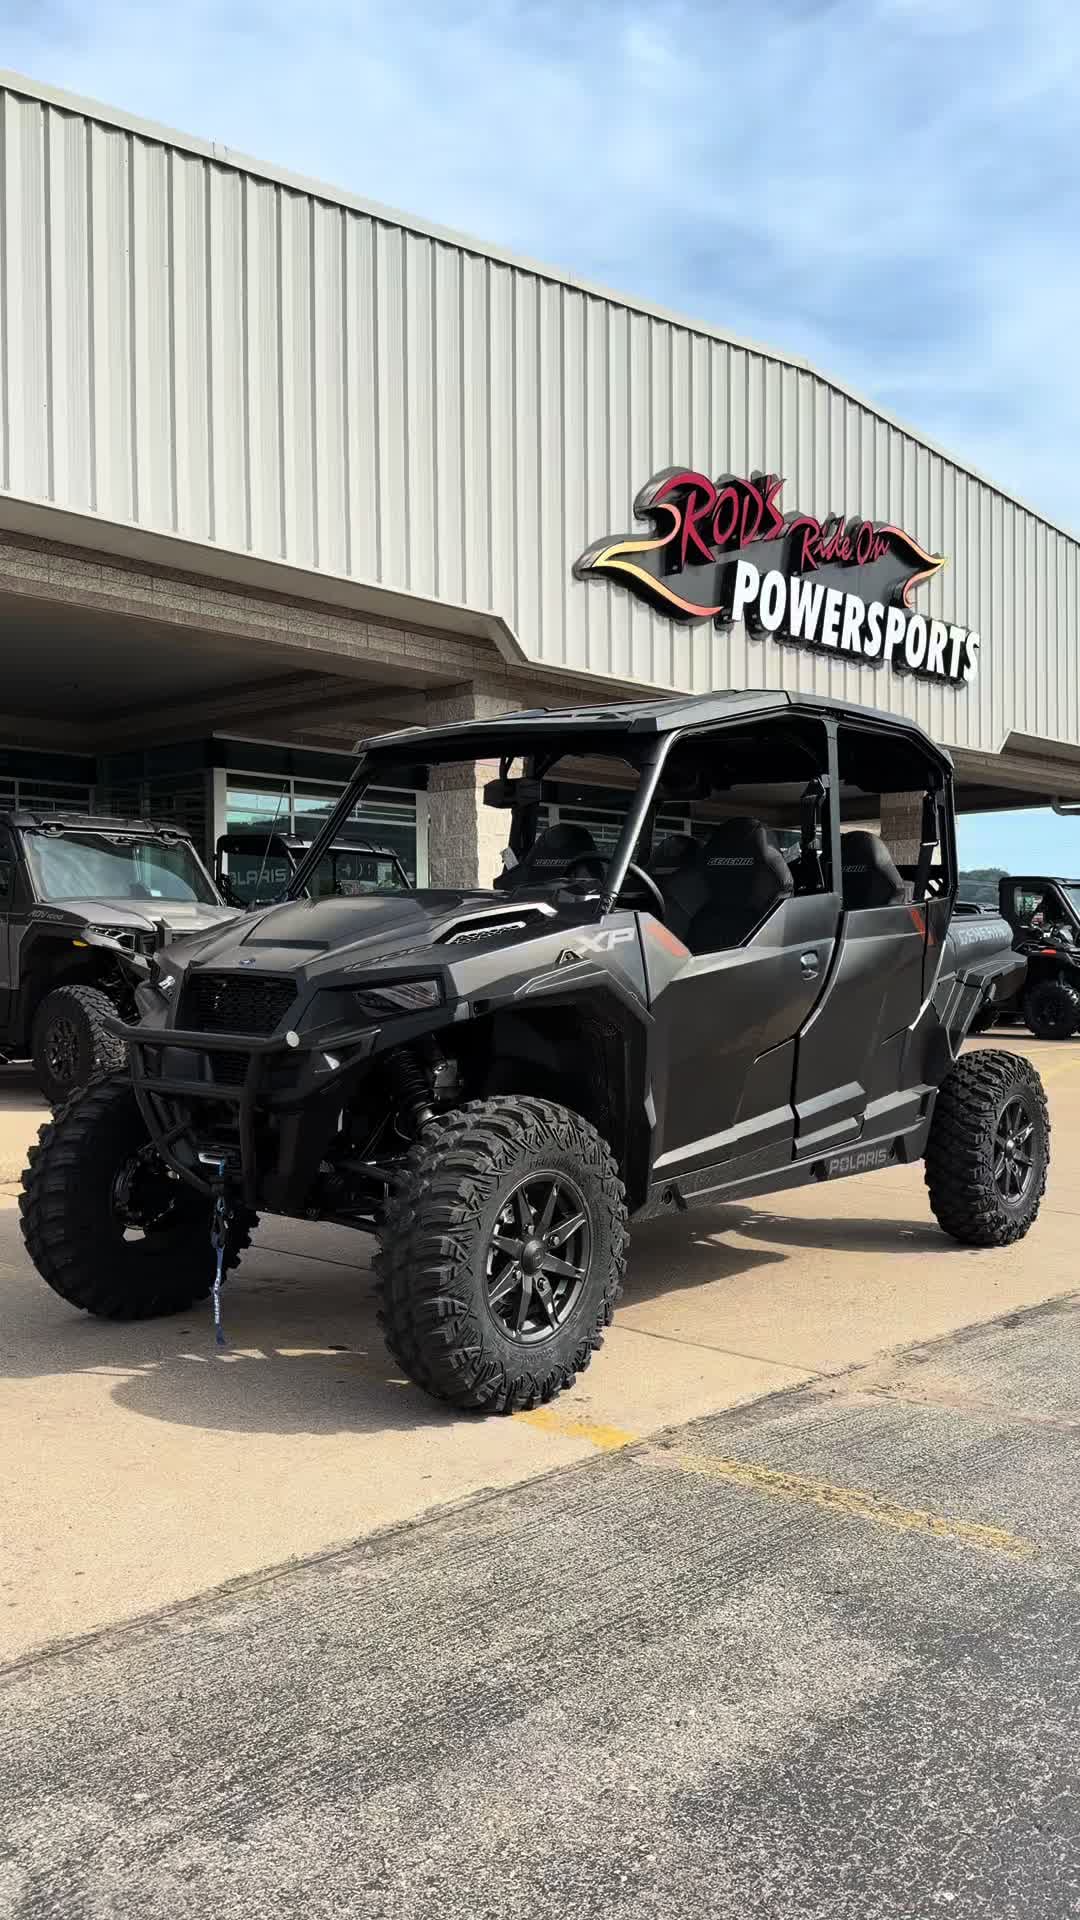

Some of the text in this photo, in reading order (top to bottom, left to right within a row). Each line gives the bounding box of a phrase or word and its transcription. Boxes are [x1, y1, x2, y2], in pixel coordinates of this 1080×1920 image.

[652, 472, 786, 567] ROD'S
[786, 516, 890, 570] Ride On
[731, 559, 980, 682] POWERSPORTS
[574, 927, 635, 953] XP
[828, 1148, 888, 1175] POLARIS
